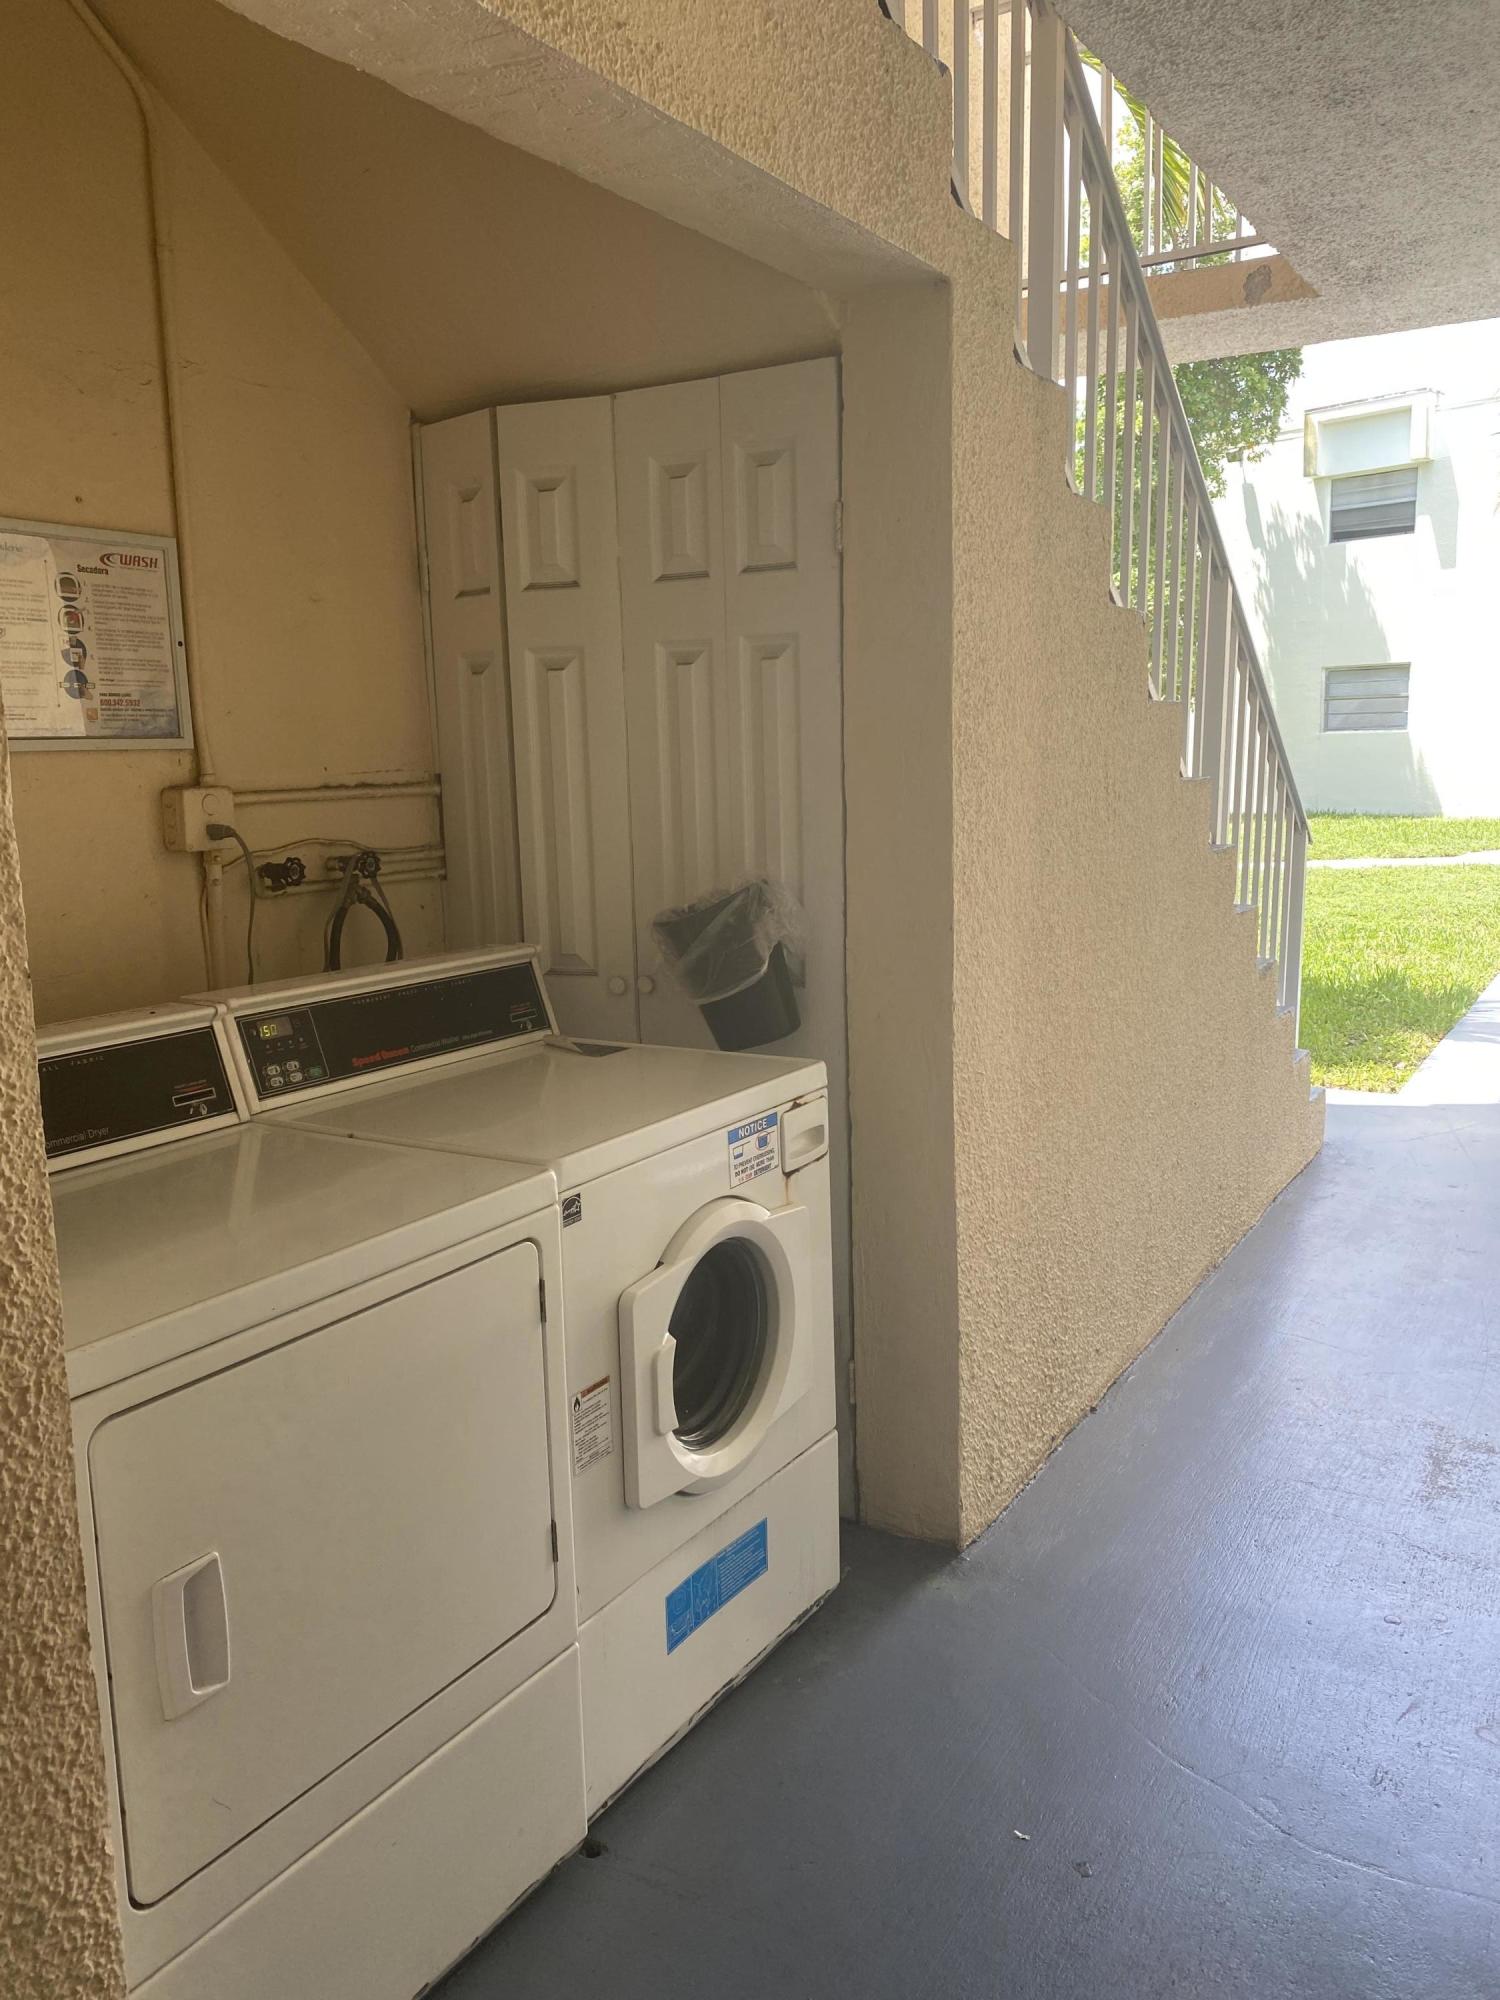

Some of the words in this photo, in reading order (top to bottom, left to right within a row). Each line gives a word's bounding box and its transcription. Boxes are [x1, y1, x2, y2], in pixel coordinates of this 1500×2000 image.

[77, 564, 109, 575] Secadora
[119, 554, 159, 569] WASH
[738, 1118, 768, 1139] NOTICE
[46, 1130, 87, 1149] ommercial
[87, 1127, 110, 1140] Dryer
